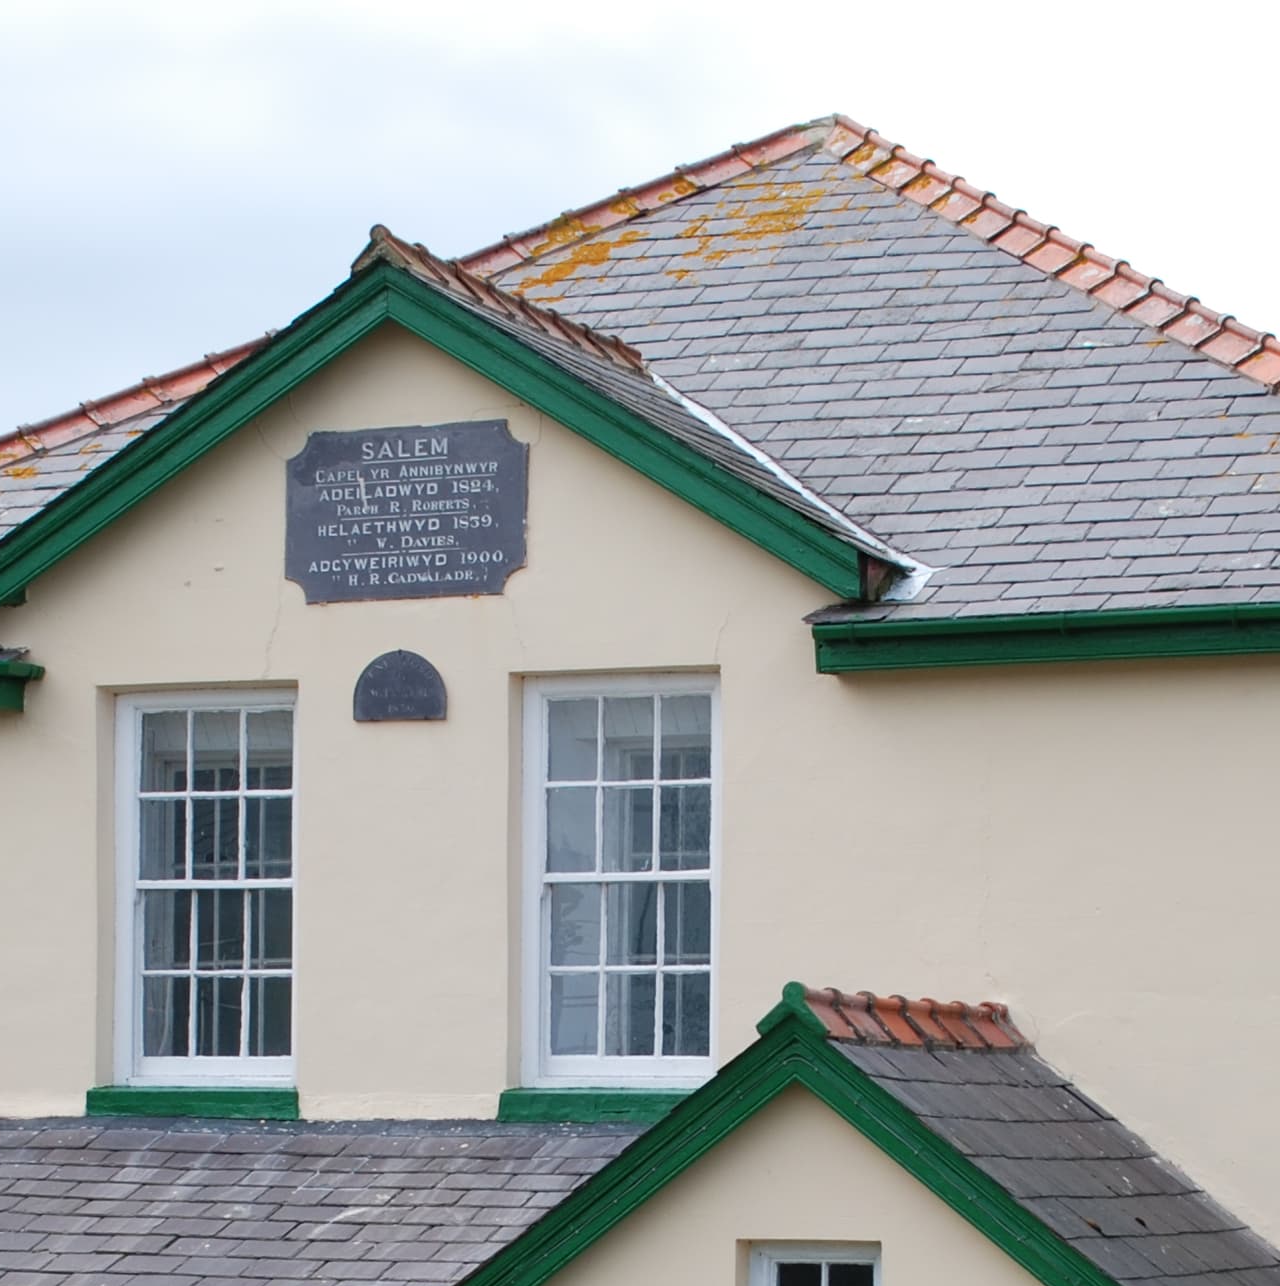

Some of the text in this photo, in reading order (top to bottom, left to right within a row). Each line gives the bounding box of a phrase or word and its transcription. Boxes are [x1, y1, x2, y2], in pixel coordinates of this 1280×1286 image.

[361, 437, 448, 460] SALEM
[315, 461, 499, 483] CAPEL YR ANNIBYNWYR
[319, 482, 438, 502] ADEILADWYD
[317, 518, 440, 537] HELAETHWYD
